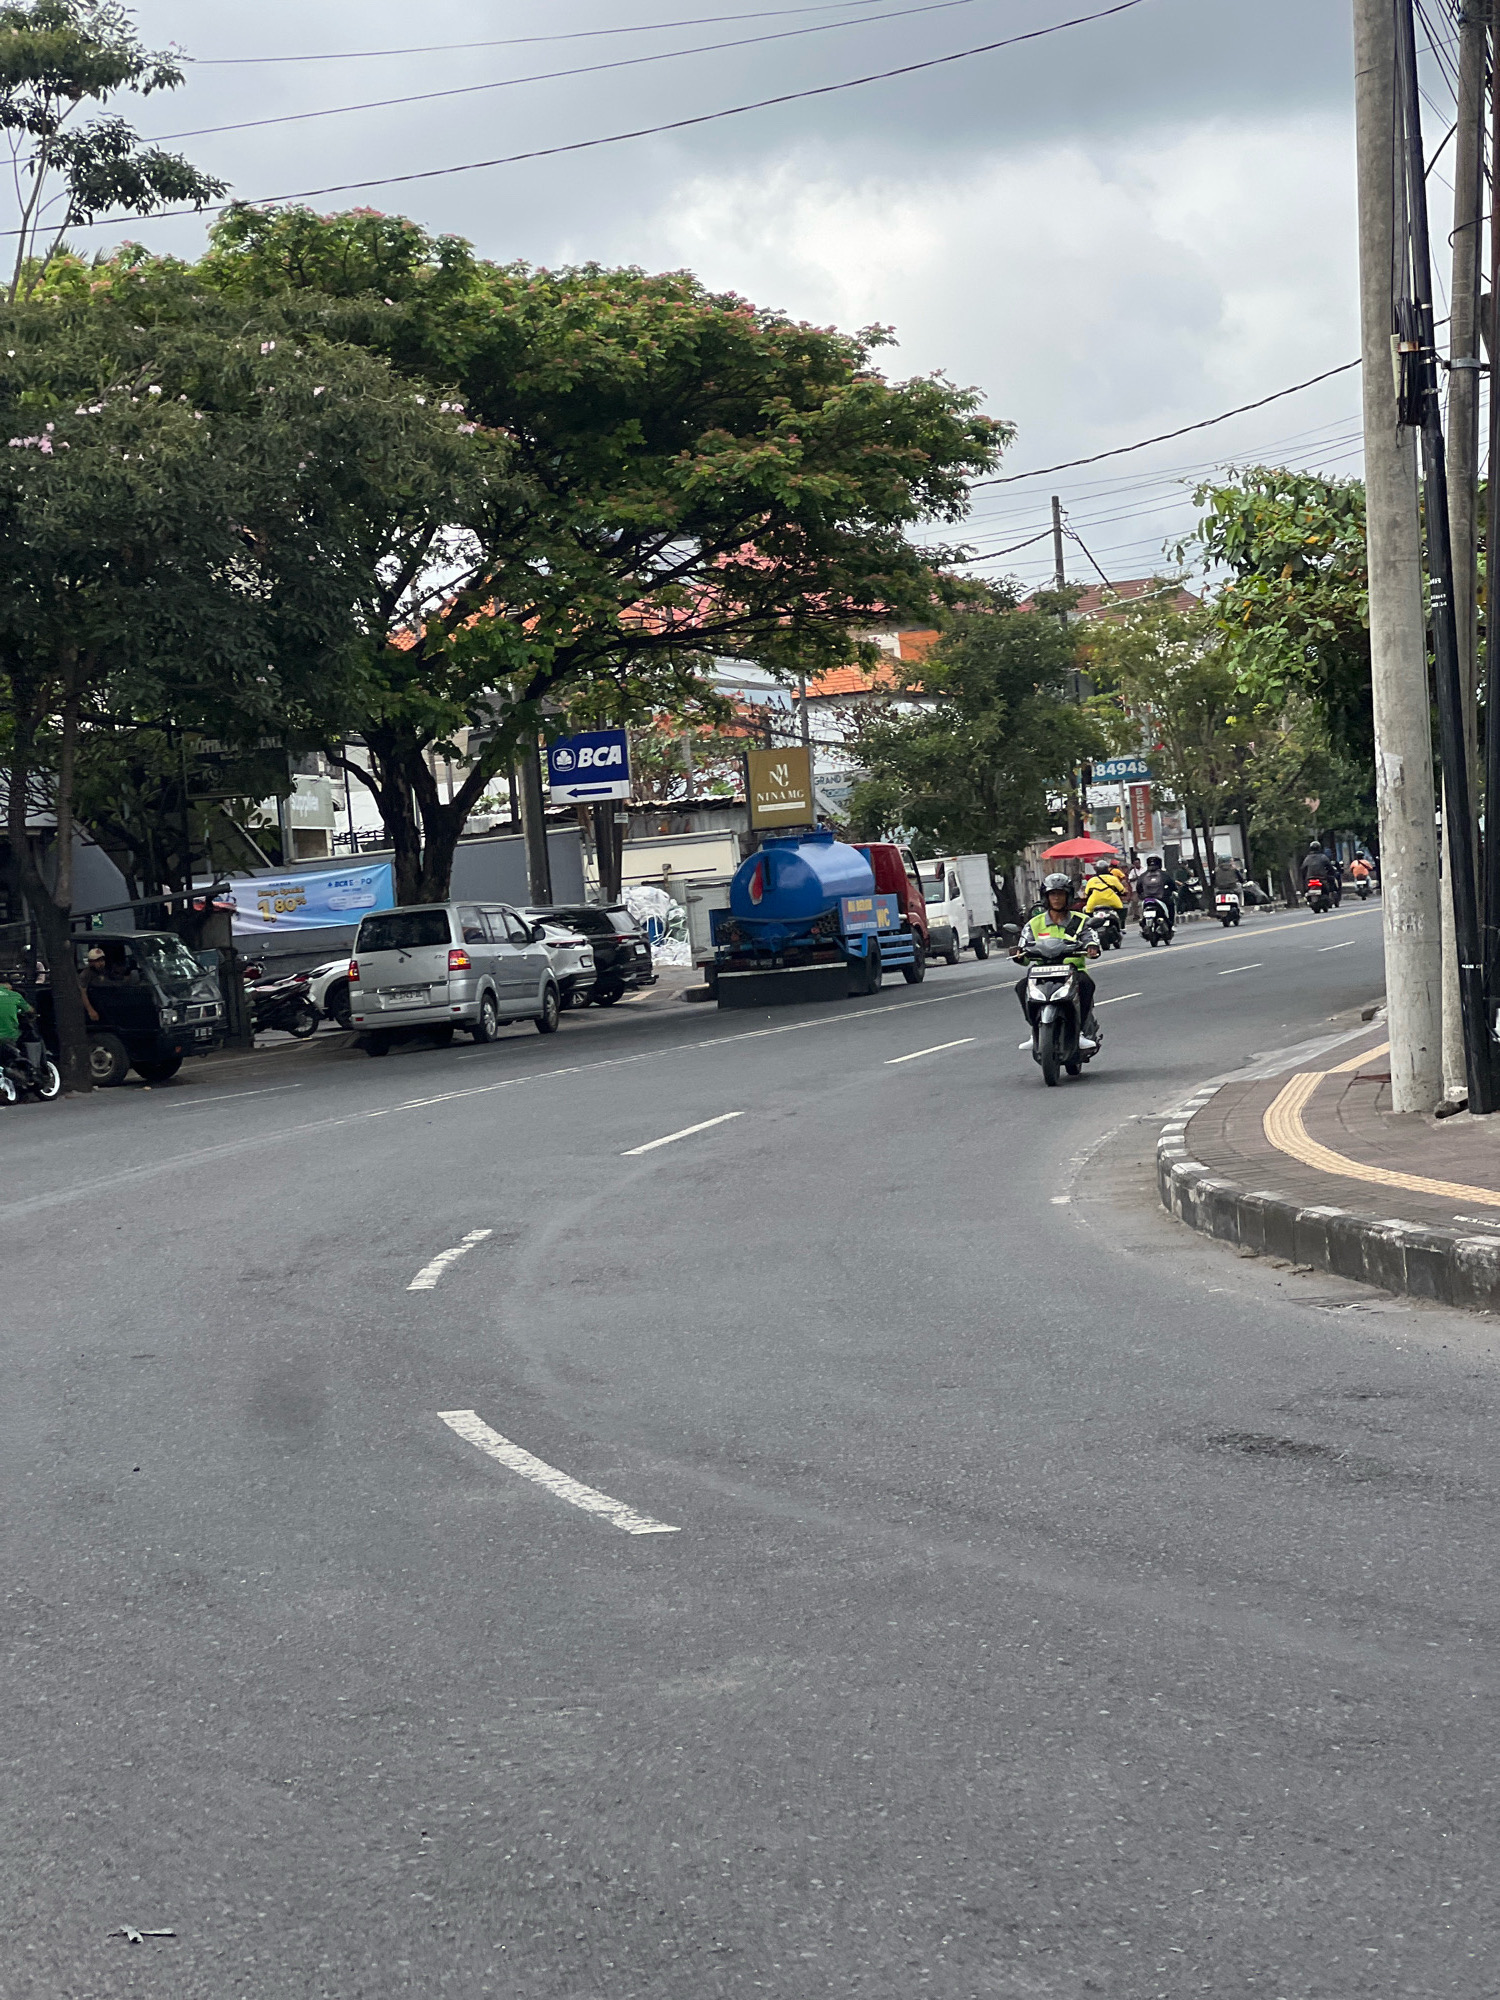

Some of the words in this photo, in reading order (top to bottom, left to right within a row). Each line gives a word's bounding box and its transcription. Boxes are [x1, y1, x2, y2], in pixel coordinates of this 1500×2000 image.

[577, 744, 622, 768] BCA
[814, 775, 841, 786] GRAND
[757, 790, 786, 802] NINA
[788, 789, 805, 799] MG
[1135, 787, 1147, 840] BENGKEL
